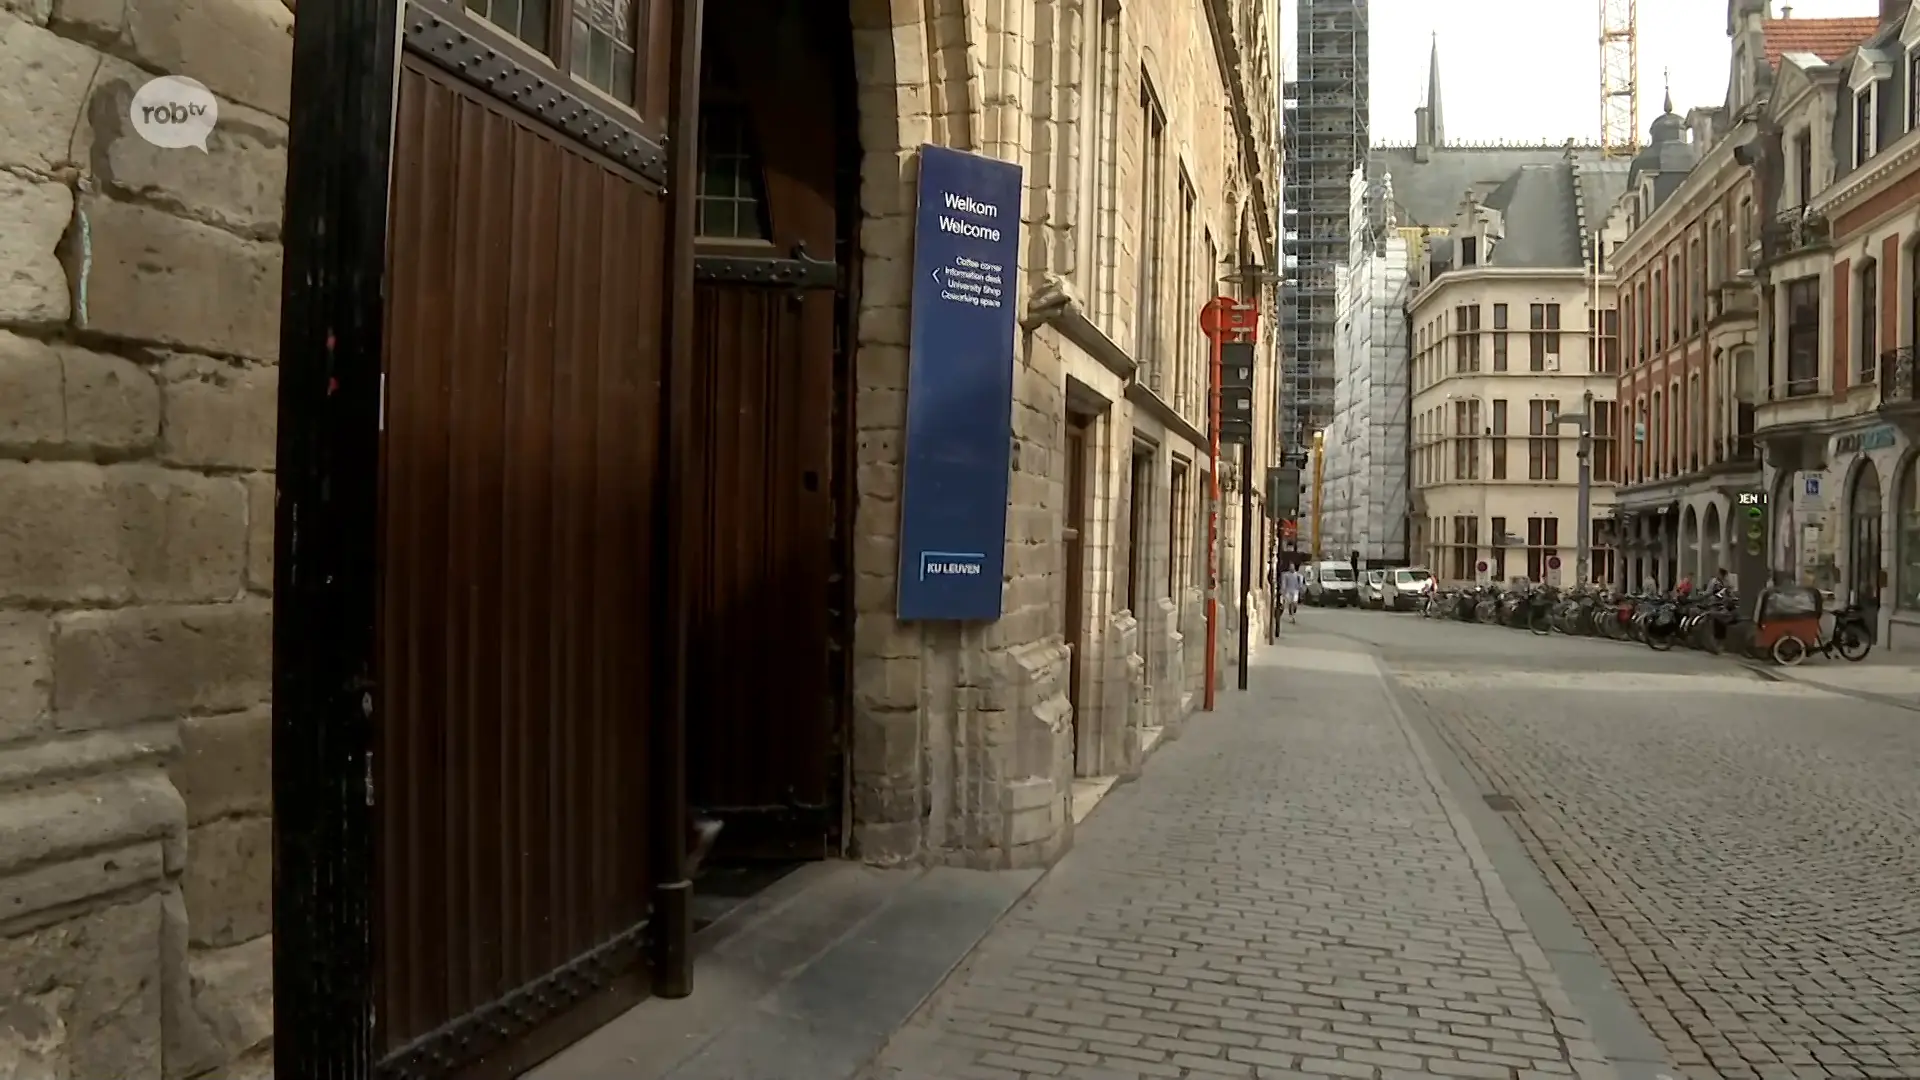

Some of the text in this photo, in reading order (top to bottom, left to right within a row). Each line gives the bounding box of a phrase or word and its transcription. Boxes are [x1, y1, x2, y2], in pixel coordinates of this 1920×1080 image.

[944, 191, 998, 218] Welkom
[939, 215, 1001, 242] Welcome
[956, 256, 980, 268] Coffee
[945, 266, 1002, 284] Information desk
[948, 278, 981, 294] University
[941, 290, 979, 306] Coworking
[927, 563, 981, 574] KU LEUVEN
